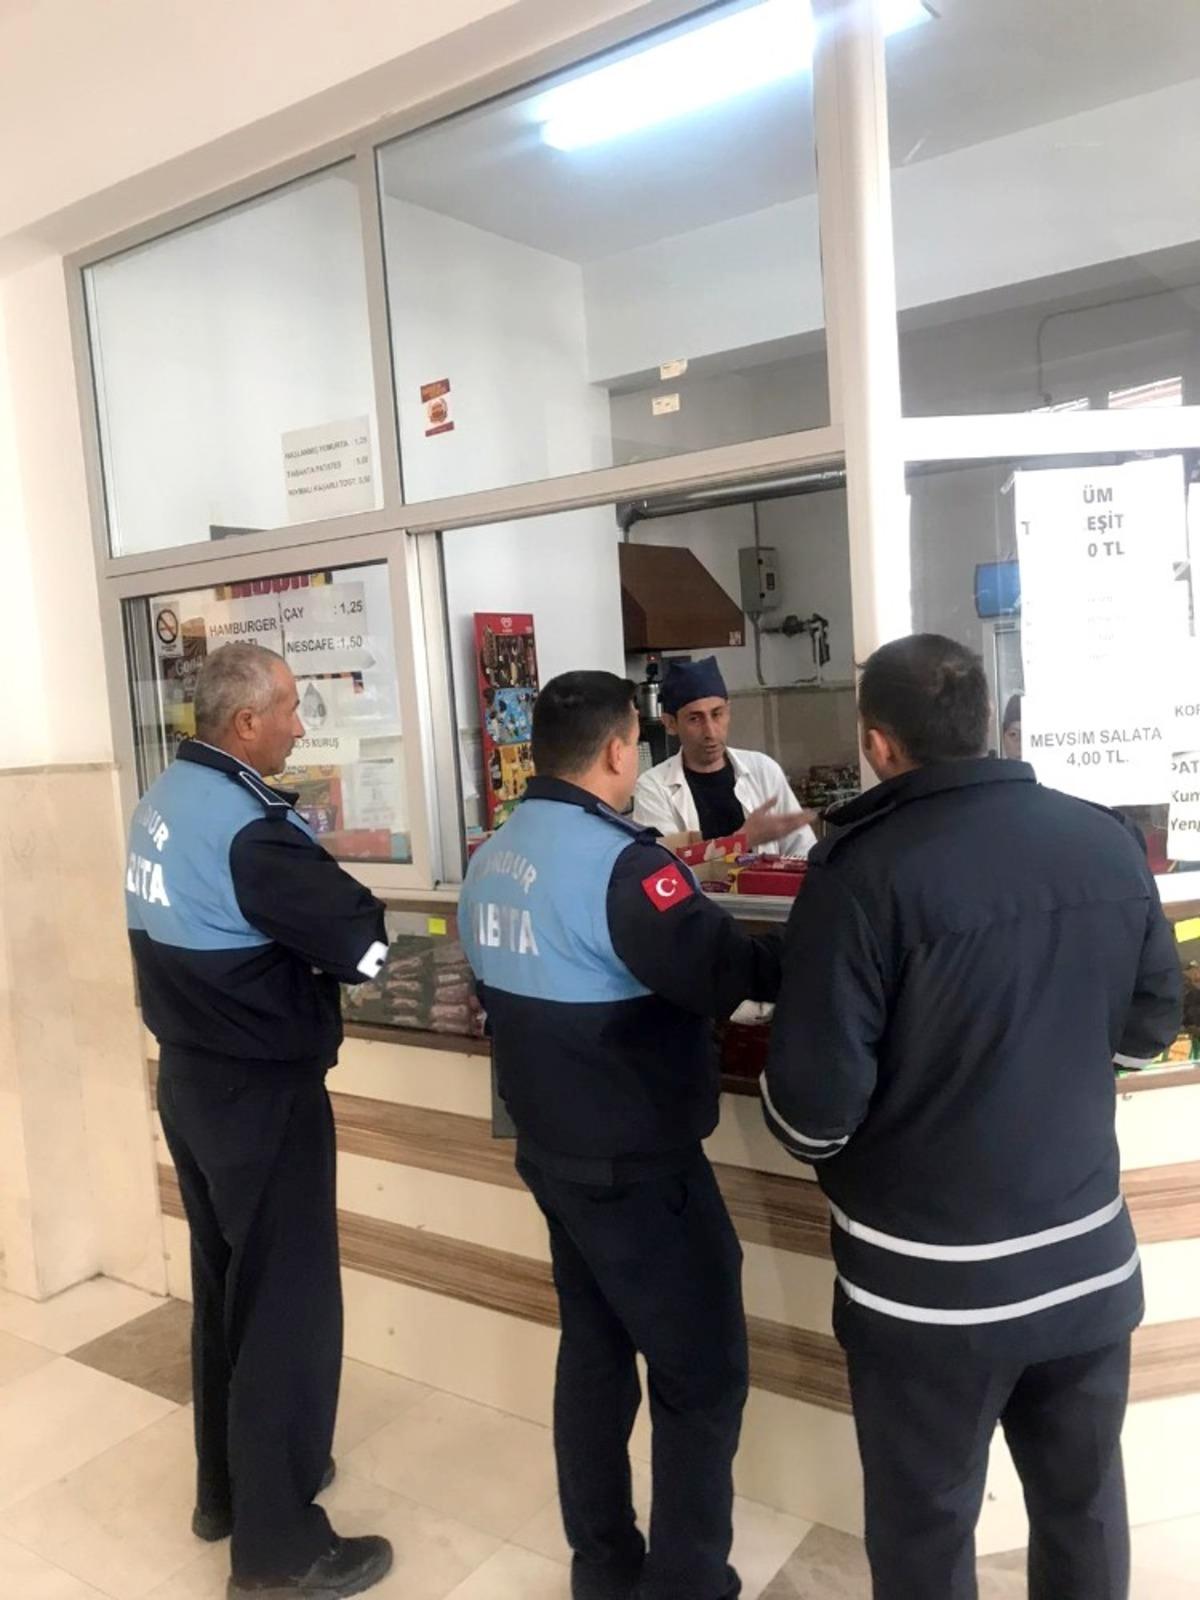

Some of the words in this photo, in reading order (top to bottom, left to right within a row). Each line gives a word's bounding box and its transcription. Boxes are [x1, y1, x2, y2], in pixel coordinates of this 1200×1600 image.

[1087, 510, 1124, 535] EŞİT
[1103, 540, 1125, 556] TL
[283, 607, 304, 622] ÇAY
[209, 617, 277, 637] HAMBURGER
[287, 638, 334, 653] NESCAFE
[1030, 729, 1095, 748] MEVSİM
[1100, 727, 1162, 744] SALATA
[1066, 750, 1101, 768] 4,00
